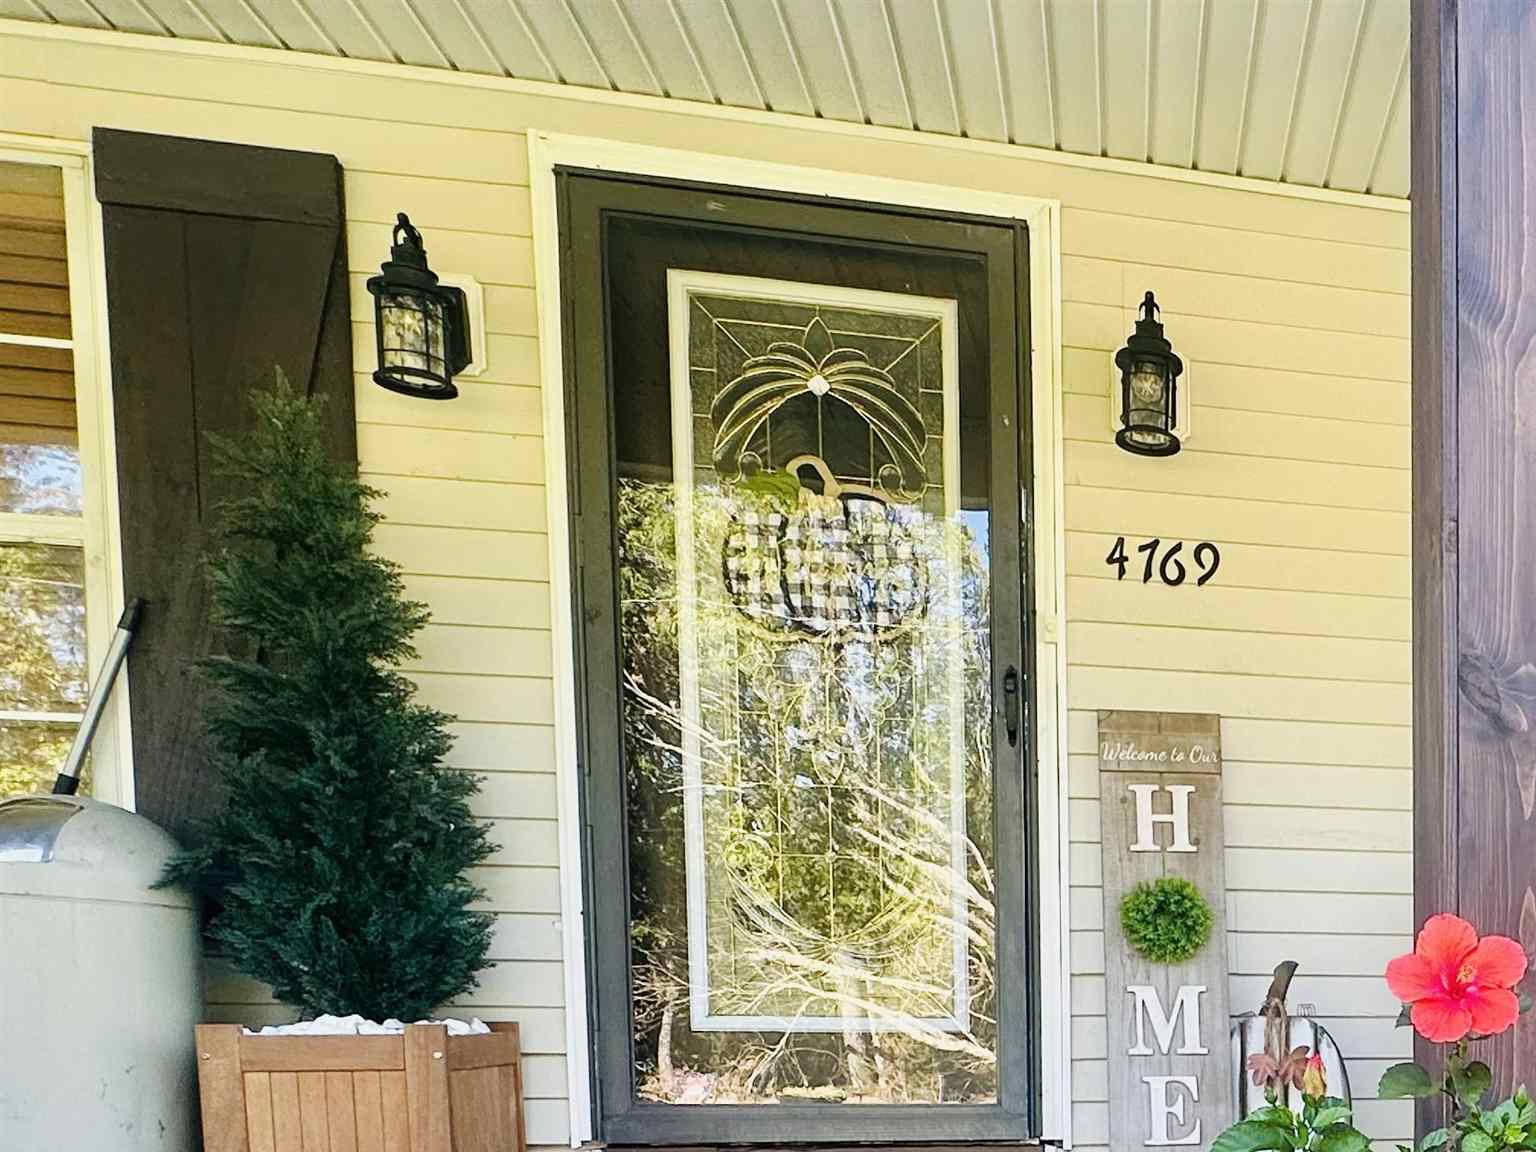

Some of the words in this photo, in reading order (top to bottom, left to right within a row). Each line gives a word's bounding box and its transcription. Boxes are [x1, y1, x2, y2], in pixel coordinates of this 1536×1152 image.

[1106, 536, 1221, 587] 4769
[1101, 742, 1168, 761] Welcome
[1170, 746, 1185, 763] to
[1189, 744, 1218, 764] Our
